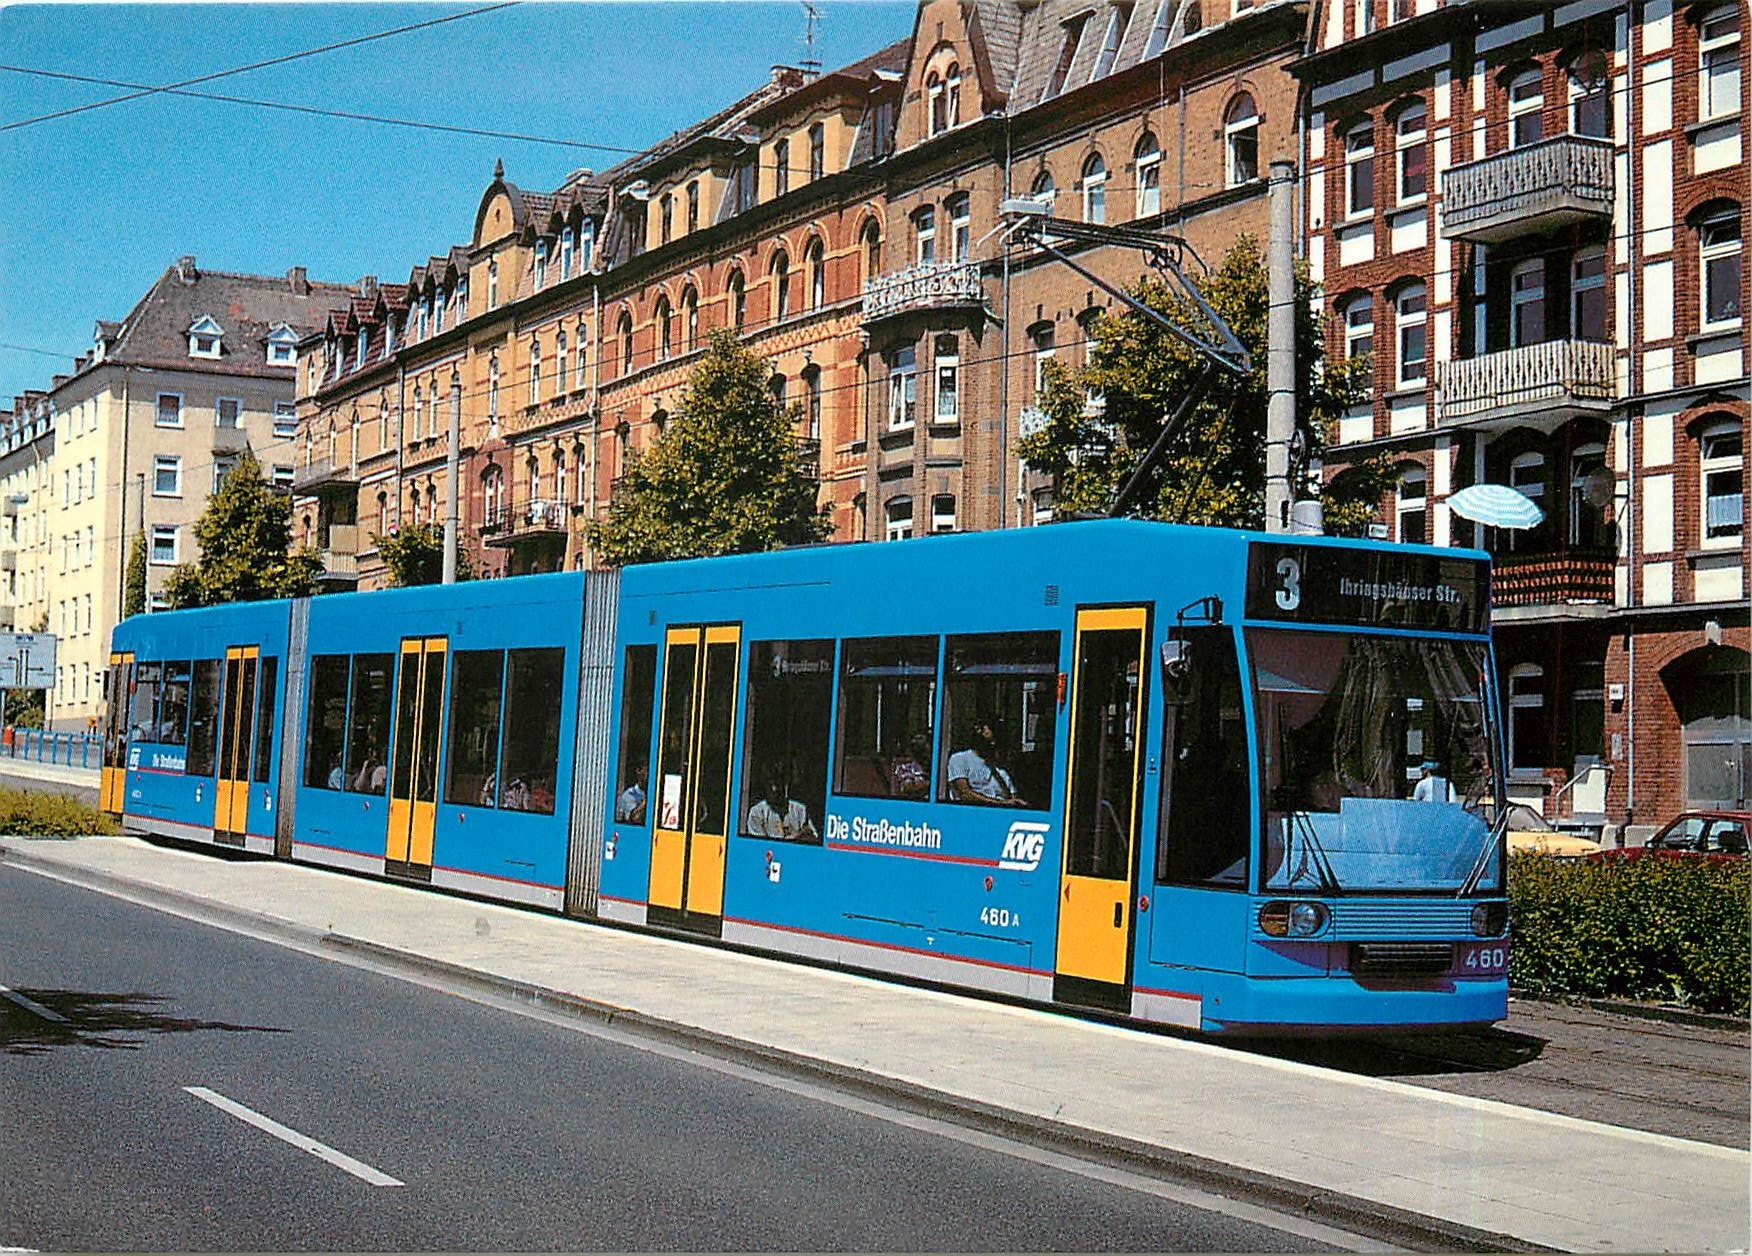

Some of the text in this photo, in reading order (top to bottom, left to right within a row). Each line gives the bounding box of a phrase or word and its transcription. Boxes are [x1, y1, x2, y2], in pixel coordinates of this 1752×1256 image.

[1275, 558, 1300, 610] 3
[1436, 584, 1460, 603] Str.
[827, 814, 941, 849] Die Straßenbahn
[1001, 831, 1044, 861] KVG
[980, 906, 1020, 927] 460 A
[1466, 949, 1504, 968] 460
